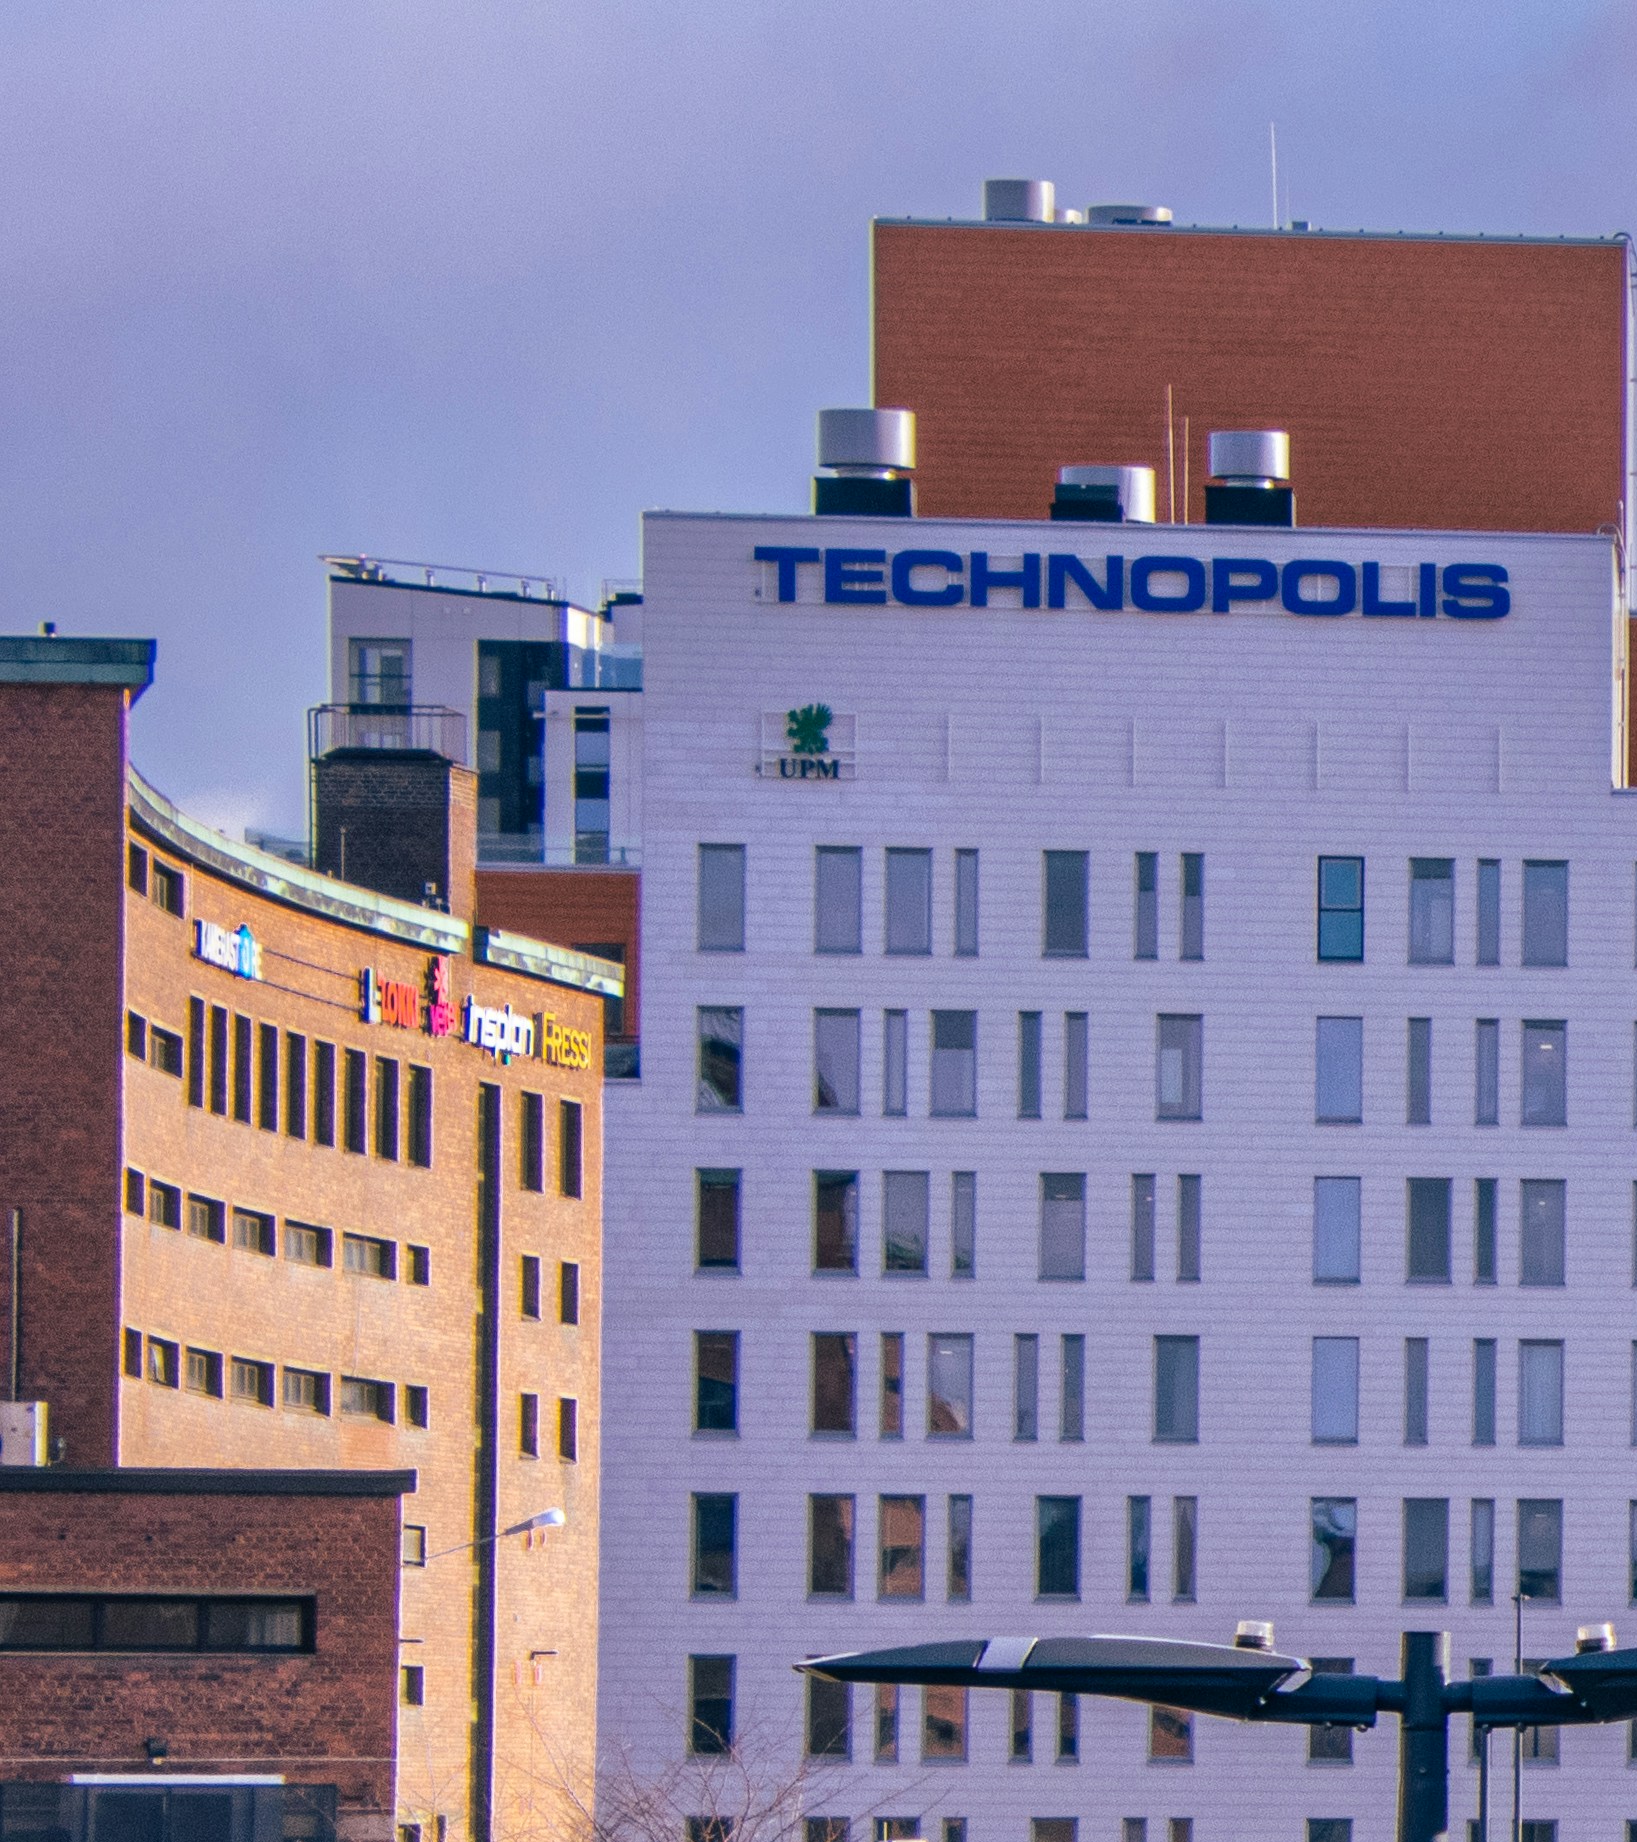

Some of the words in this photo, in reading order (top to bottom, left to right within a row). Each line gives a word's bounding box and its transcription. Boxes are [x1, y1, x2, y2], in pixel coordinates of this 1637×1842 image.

[754, 546, 1511, 619] TECHNOPOLIS
[780, 758, 839, 778] UPM
[540, 1011, 592, 1069] FRESSI
